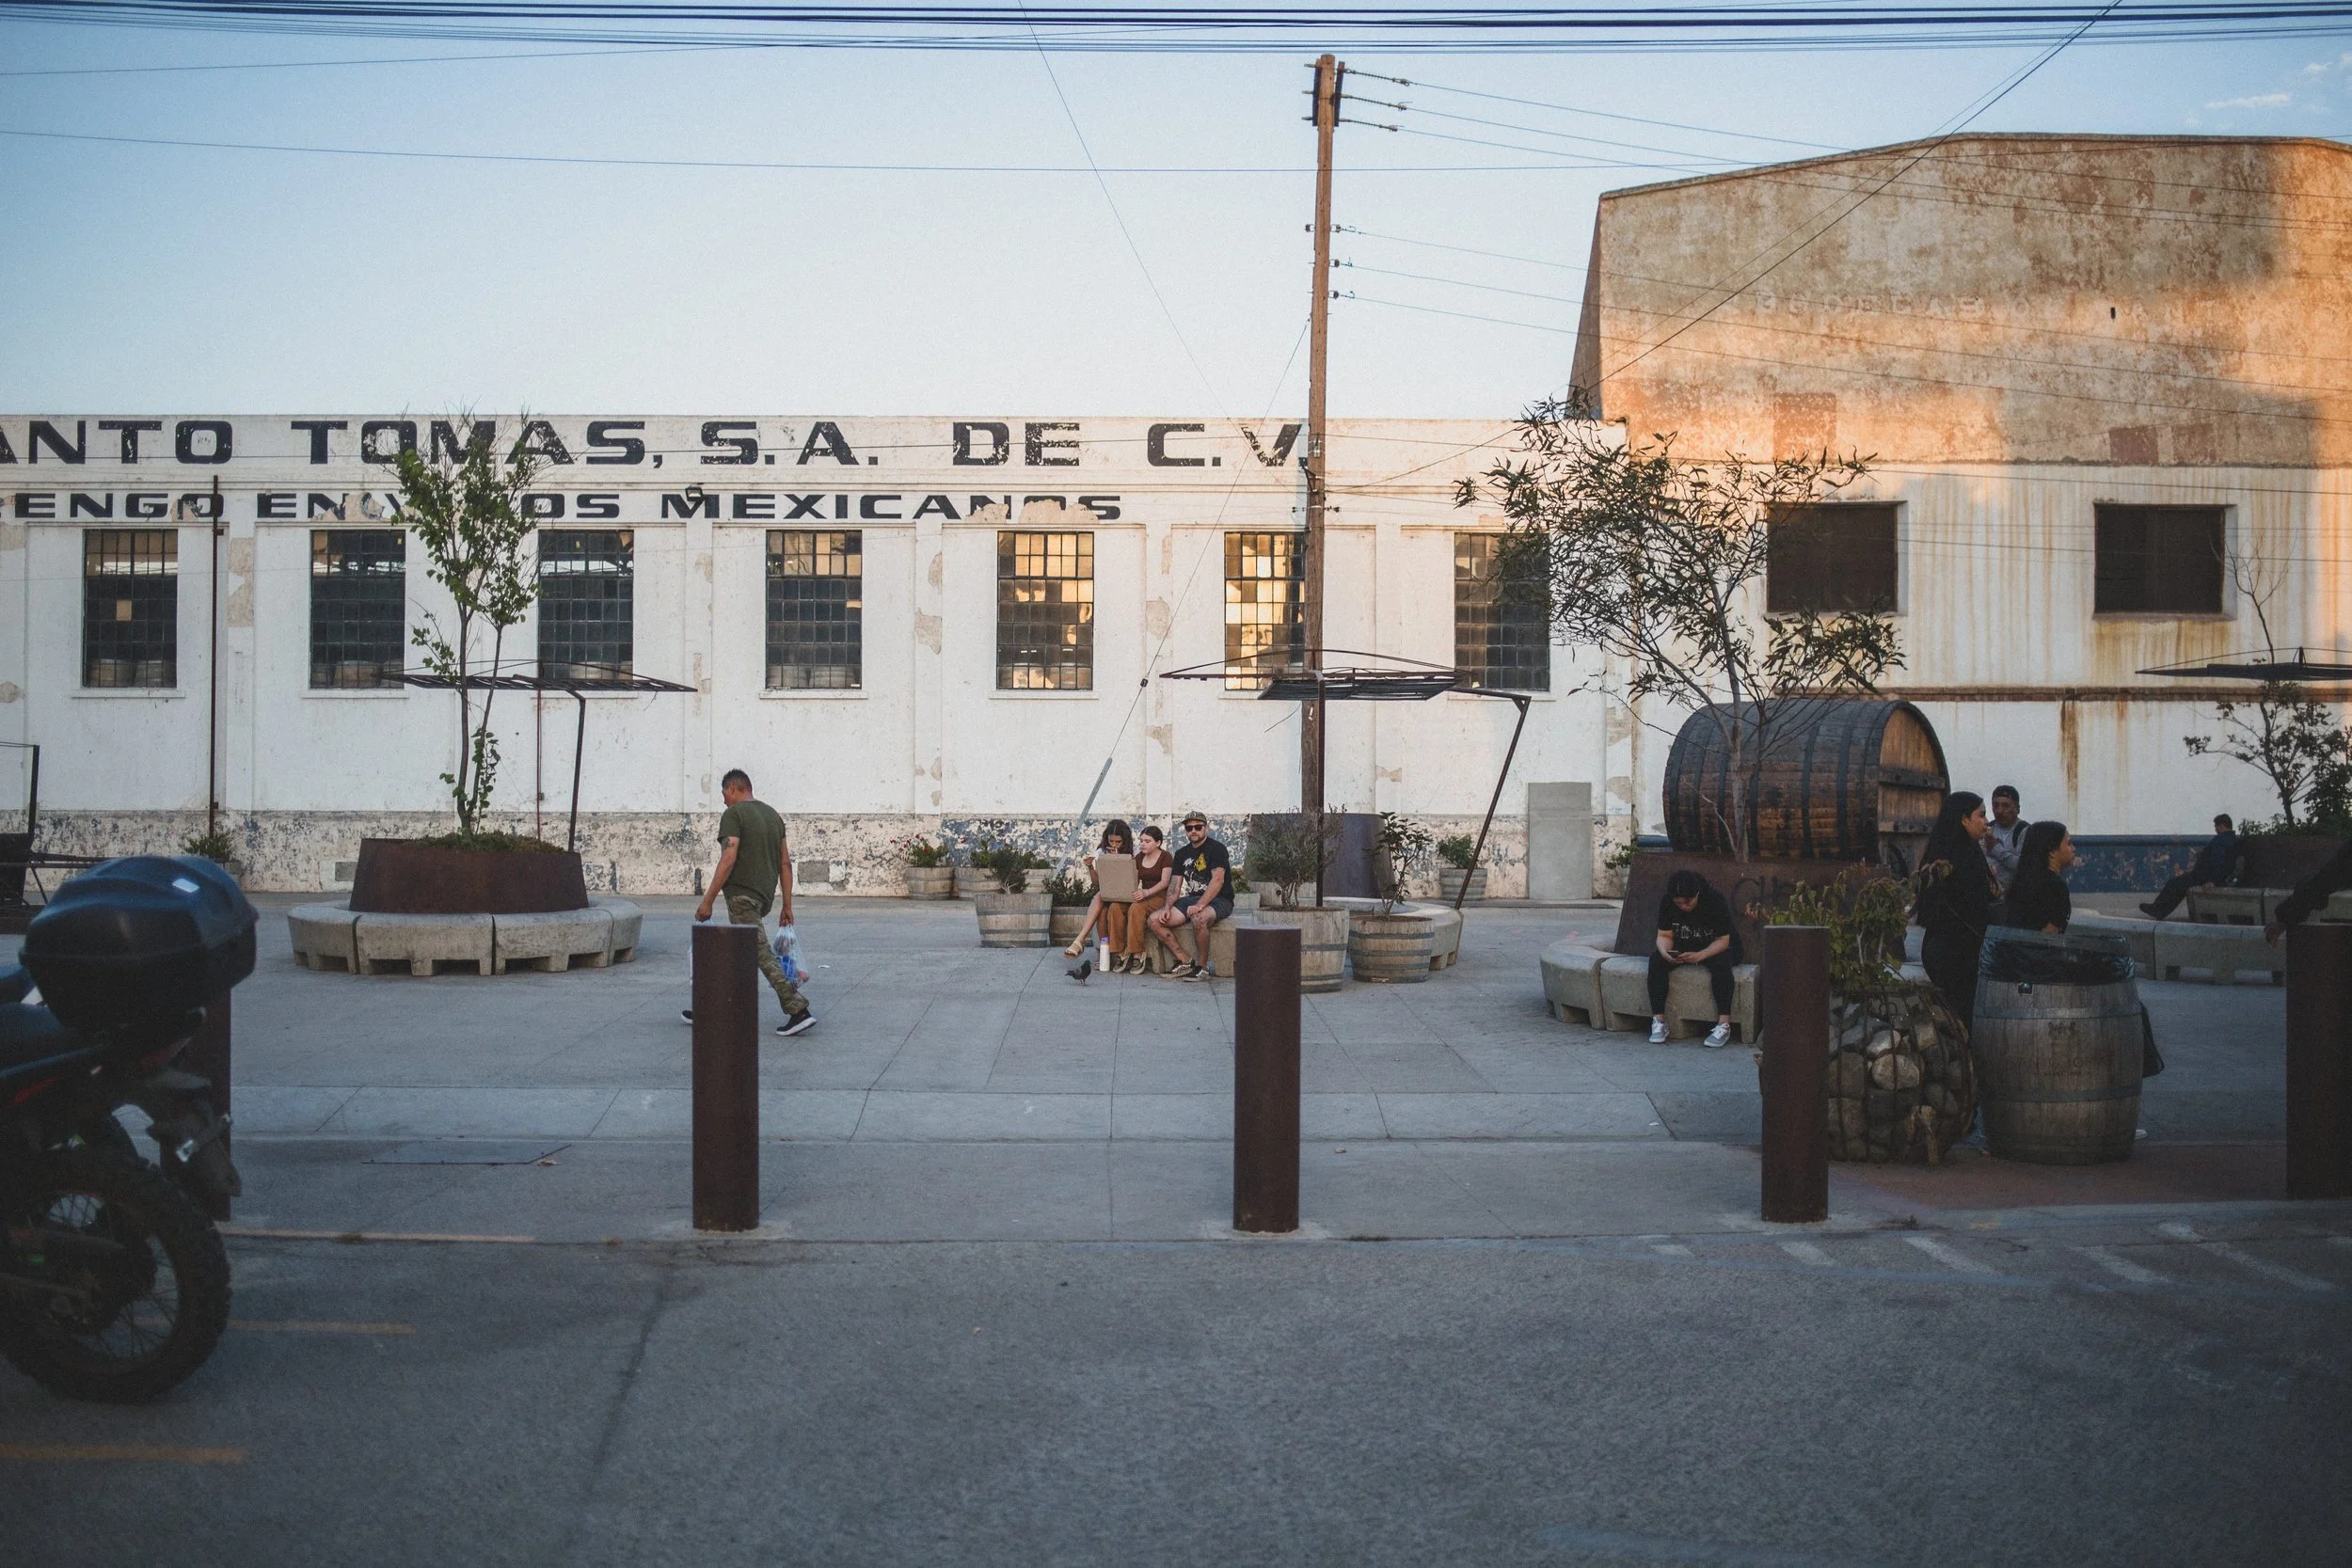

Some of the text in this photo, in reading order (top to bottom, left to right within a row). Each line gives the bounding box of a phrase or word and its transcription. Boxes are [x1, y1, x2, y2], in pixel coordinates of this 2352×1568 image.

[0, 420, 232, 464] NTO
[700, 420, 878, 466] S.A.
[952, 421, 1079, 467] DE
